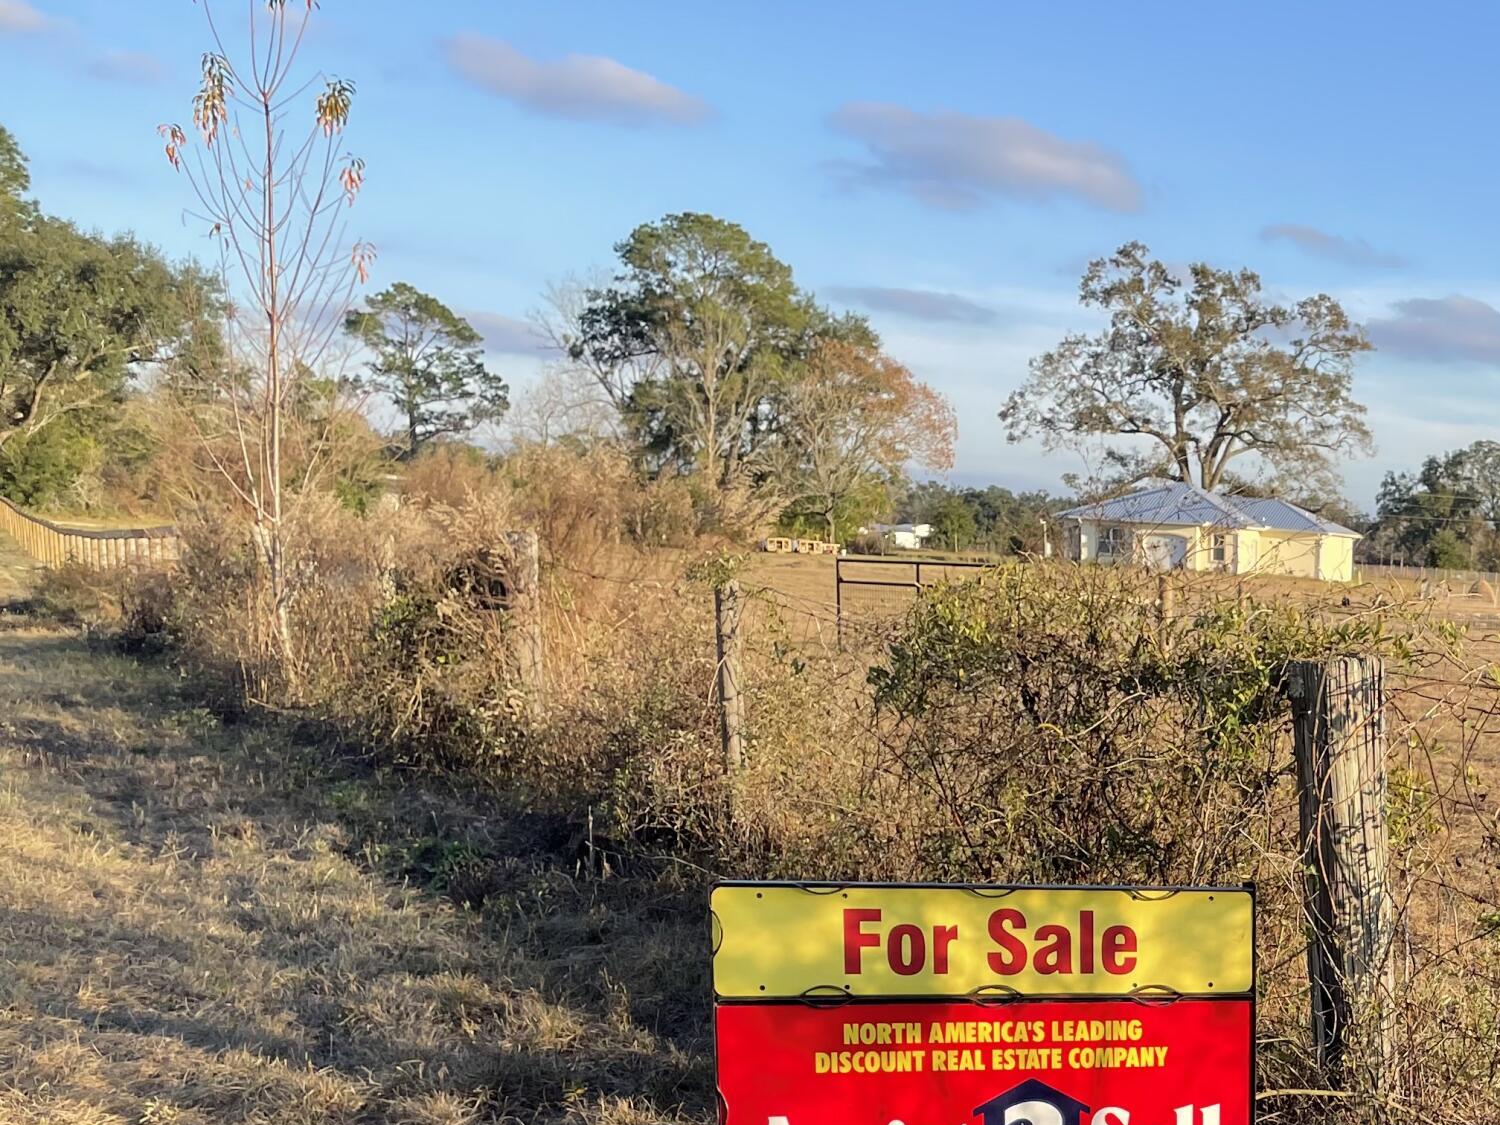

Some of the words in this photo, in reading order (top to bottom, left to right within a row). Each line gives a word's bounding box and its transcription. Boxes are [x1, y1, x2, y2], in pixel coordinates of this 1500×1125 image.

[843, 908, 958, 976] For
[987, 904, 1138, 975] Sale
[843, 1022, 922, 1044] NORTH
[928, 1021, 1046, 1043] AMERICA'S
[1051, 1020, 1143, 1042] LEADING
[815, 1051, 923, 1074] DISCOUNT
[932, 1049, 985, 1071] REAL
[991, 1048, 1063, 1070] ESTATE
[1068, 1046, 1168, 1068] COMPANY
